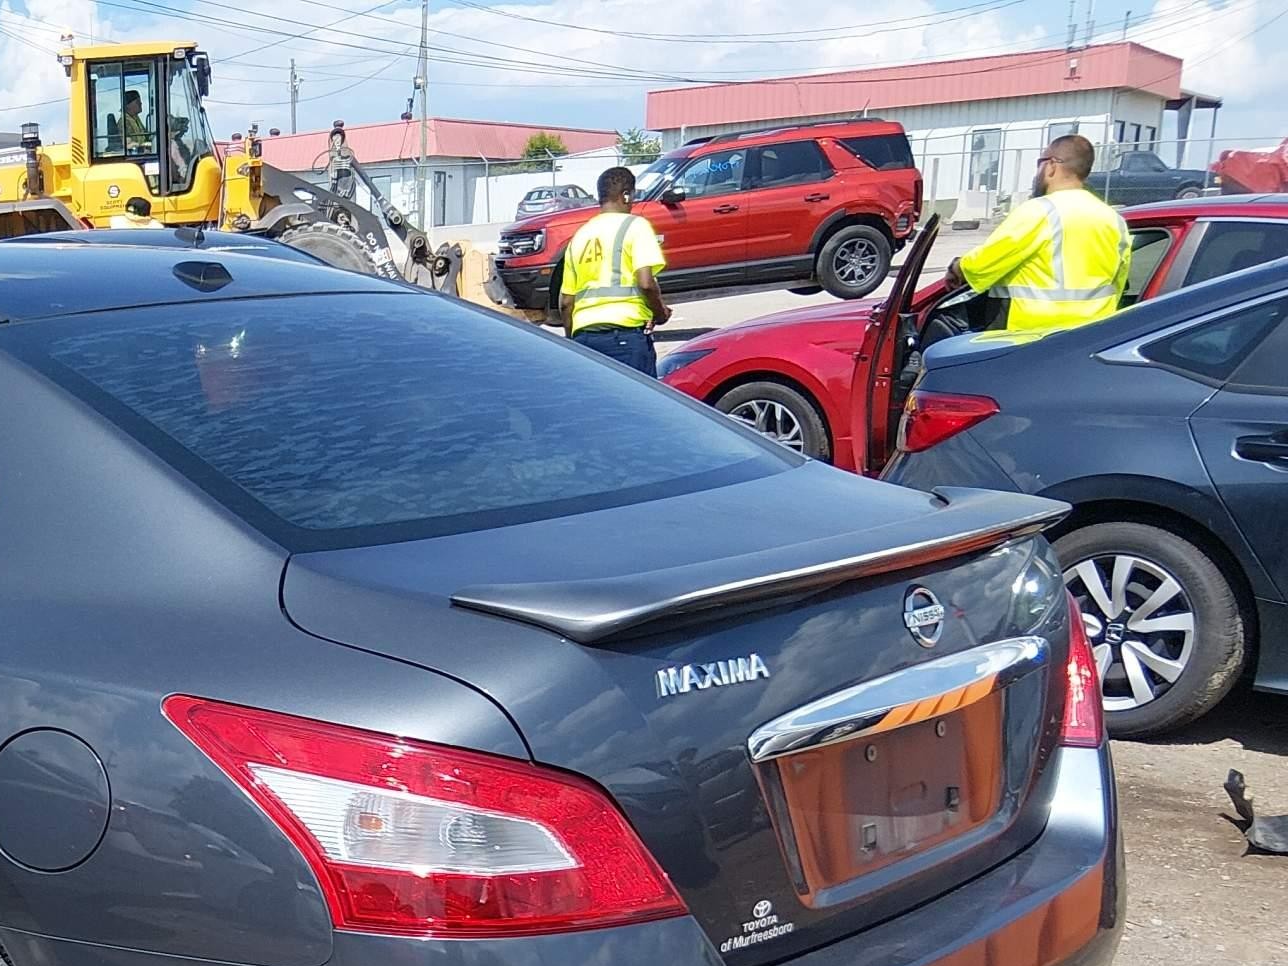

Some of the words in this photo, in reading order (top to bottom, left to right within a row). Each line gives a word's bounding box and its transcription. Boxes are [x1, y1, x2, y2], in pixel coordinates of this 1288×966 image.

[655, 653, 771, 699] MAXIMA
[720, 938, 733, 953] of
[732, 922, 794, 950] Murfreesboro
[742, 914, 778, 933] TOYOTA
